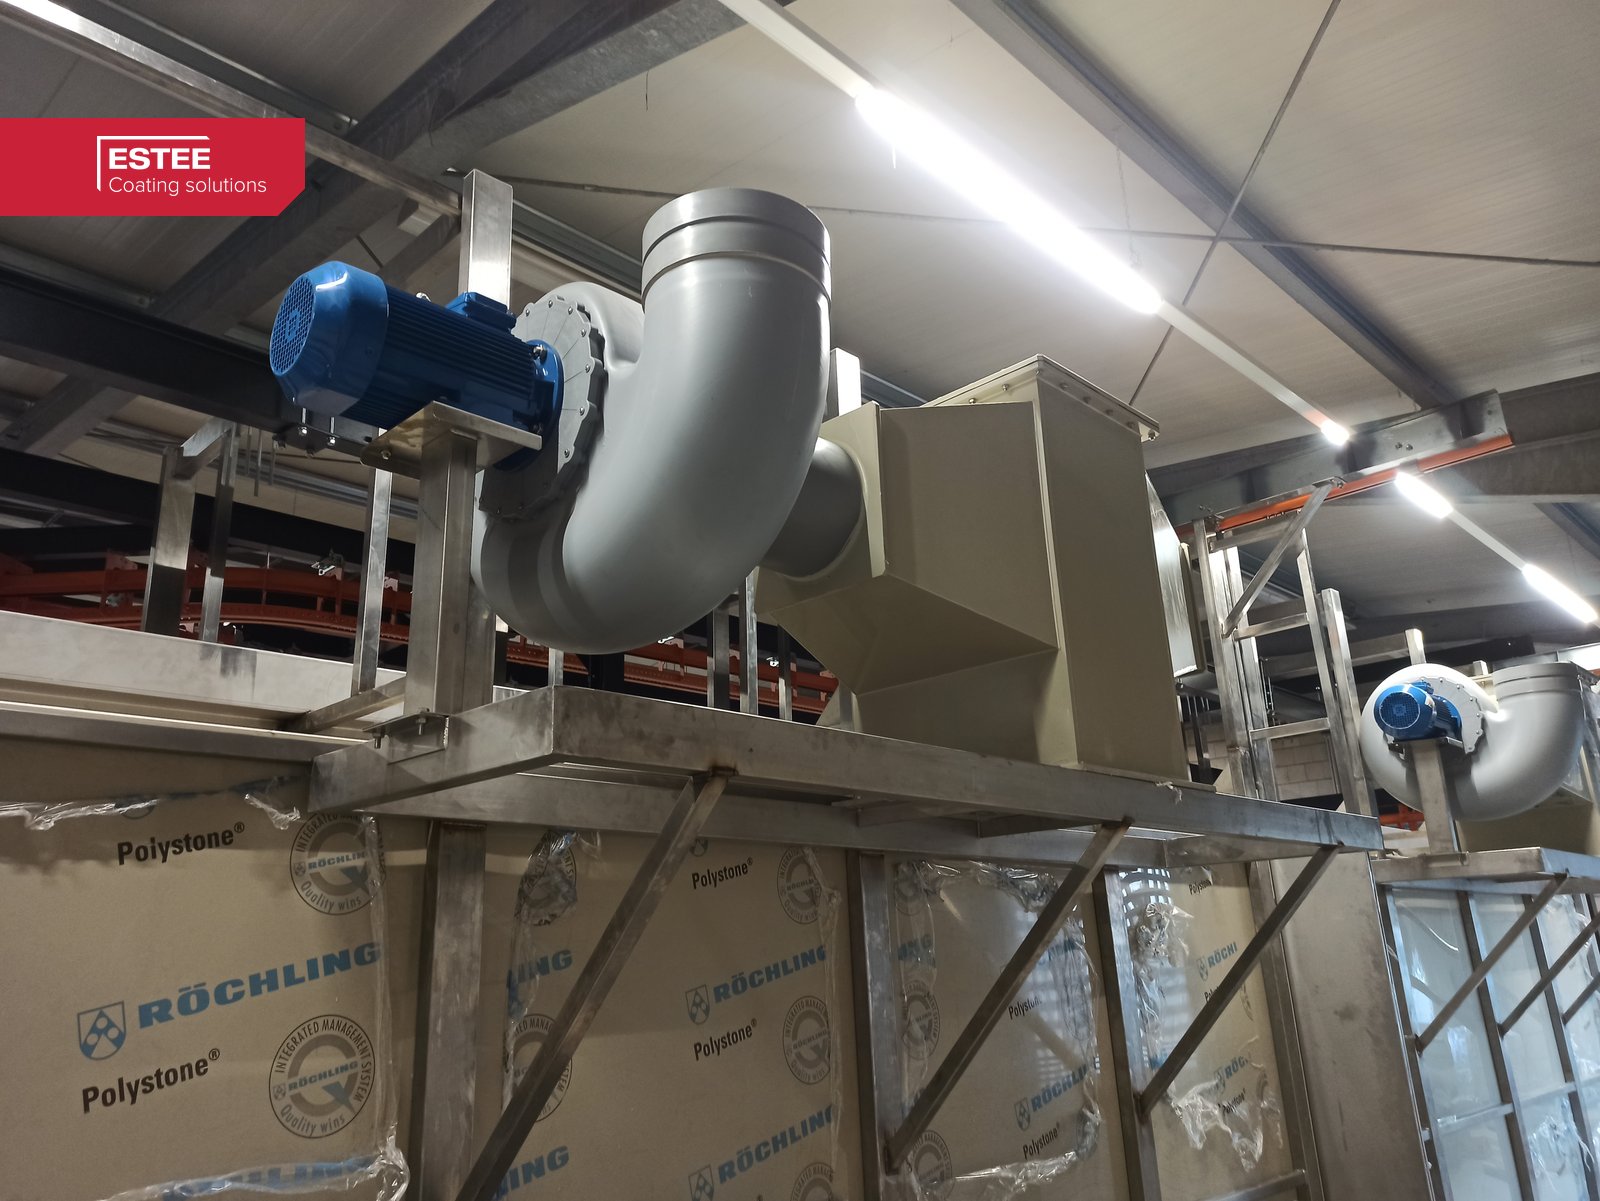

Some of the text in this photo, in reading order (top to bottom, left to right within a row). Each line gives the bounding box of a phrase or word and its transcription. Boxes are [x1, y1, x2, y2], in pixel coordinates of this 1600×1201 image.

[138, 941, 382, 1029] RÖCHLING
[82, 1048, 220, 1115] Polystone®
[274, 1018, 372, 1103] INTEGRATED MANAGEMENT SYSTEM
[280, 1103, 346, 1137] Quality wins
